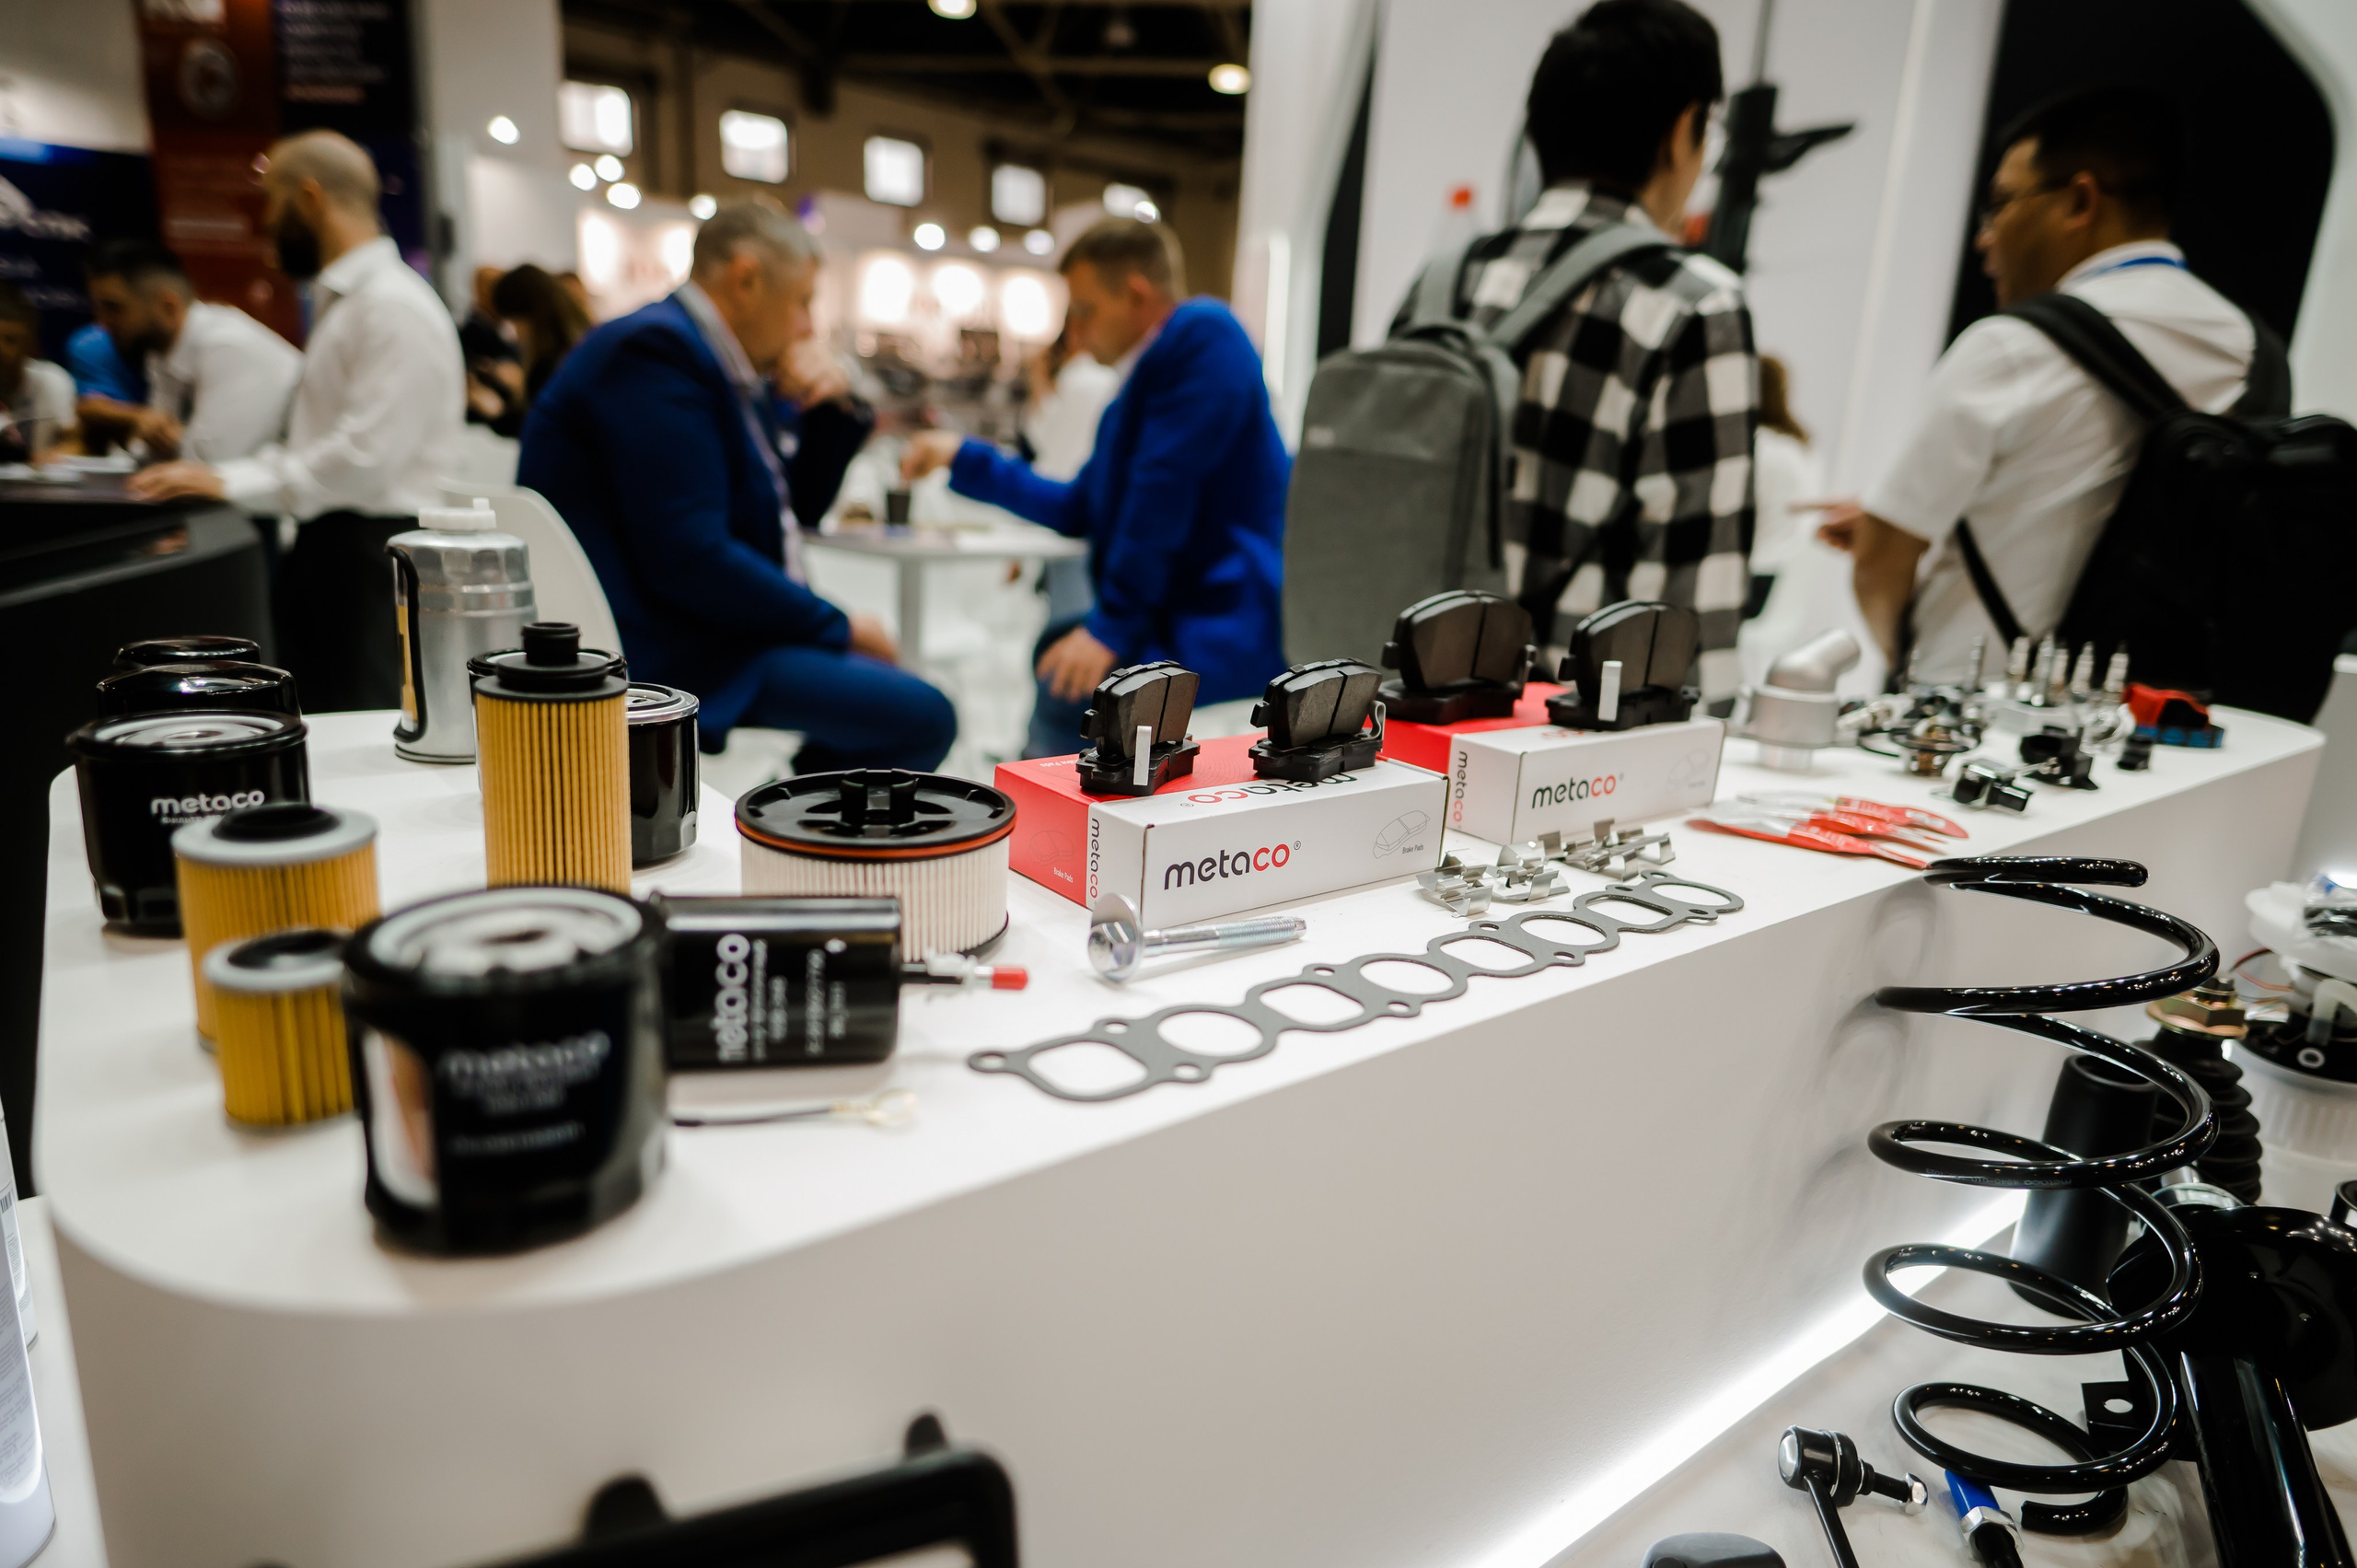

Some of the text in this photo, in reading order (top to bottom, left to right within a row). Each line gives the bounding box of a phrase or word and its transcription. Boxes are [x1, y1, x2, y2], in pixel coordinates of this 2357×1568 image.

[149, 790, 265, 815] metaco
[1453, 750, 1469, 823] metaco
[1531, 774, 1617, 809] metaco
[1089, 817, 1100, 899] metaco
[1402, 842, 1424, 854] Brake Pads
[1053, 866, 1074, 884] Brake Pads
[1163, 843, 1291, 890] metaco
